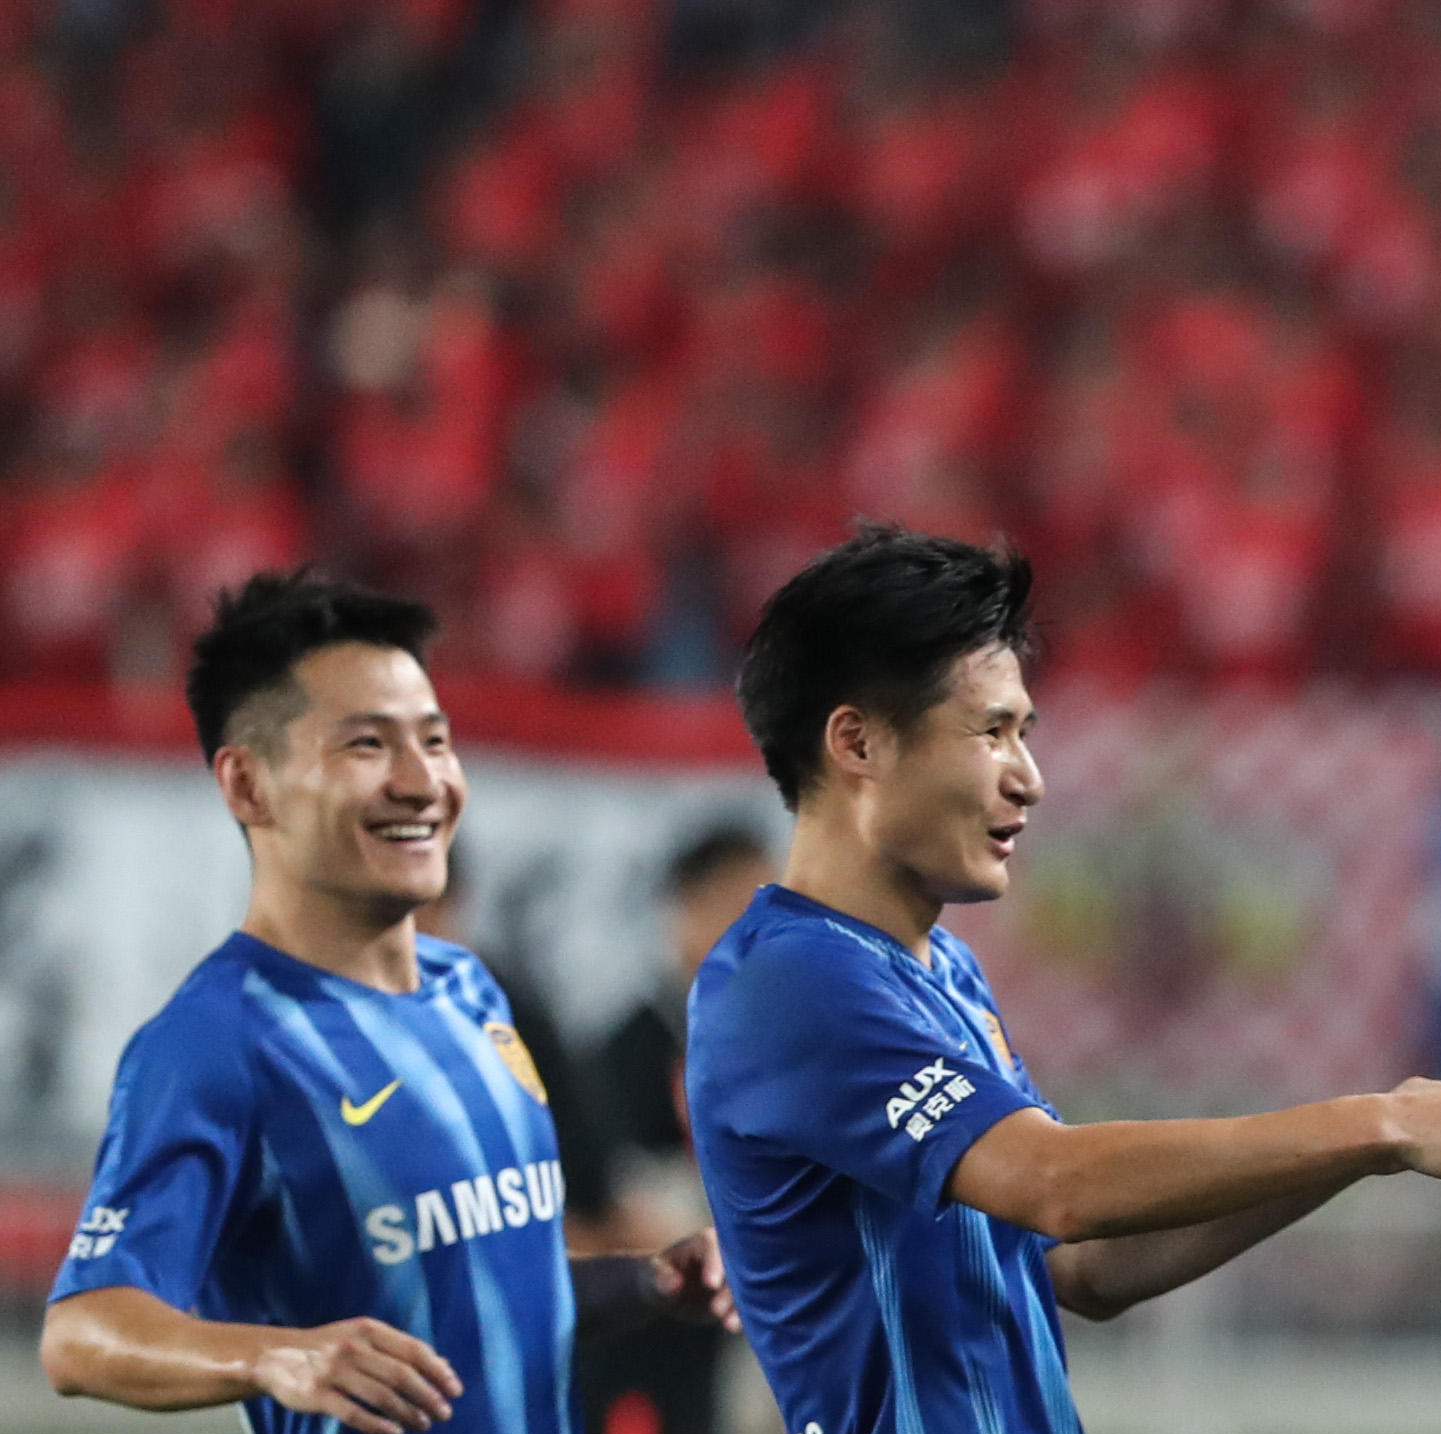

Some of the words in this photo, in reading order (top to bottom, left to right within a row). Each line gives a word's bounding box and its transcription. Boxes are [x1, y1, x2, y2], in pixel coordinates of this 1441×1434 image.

[886, 1057, 957, 1129] AUX
[905, 1075, 976, 1142] 奥克斯
